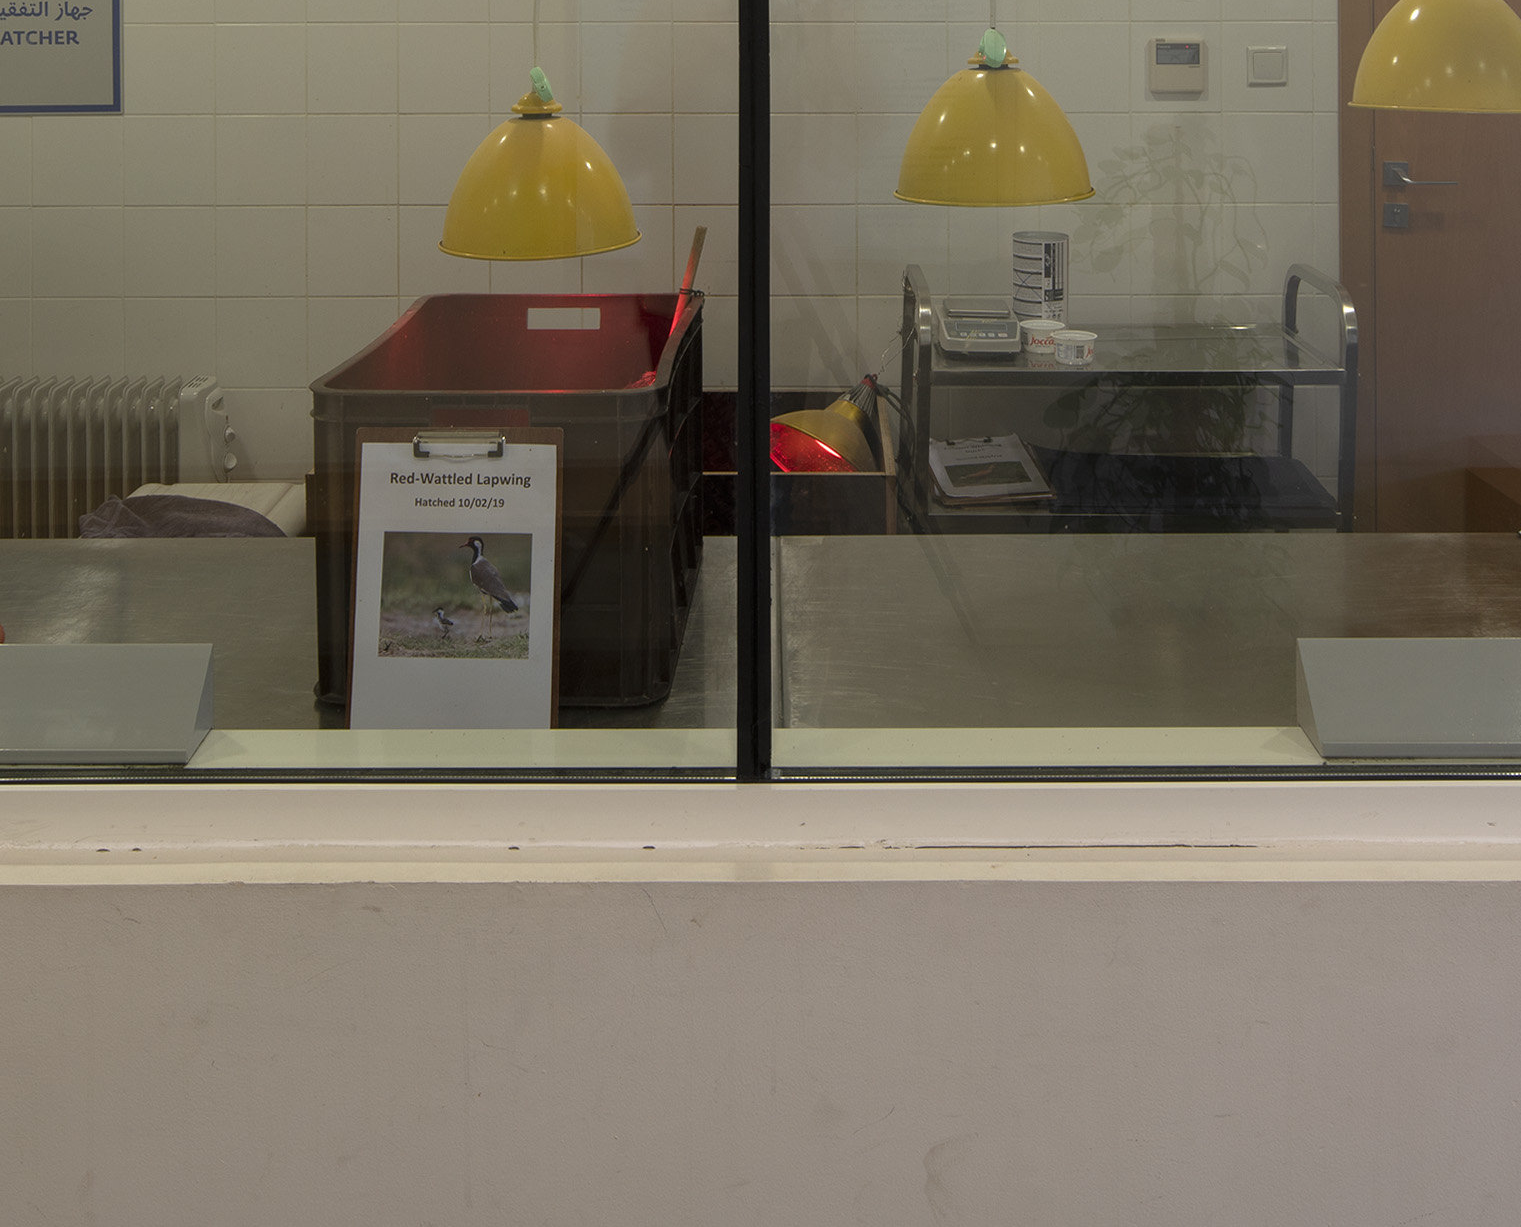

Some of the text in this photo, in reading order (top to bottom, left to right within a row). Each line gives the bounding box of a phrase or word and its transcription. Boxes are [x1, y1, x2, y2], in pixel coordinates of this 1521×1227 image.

[55, 1, 93, 20] جهاز
[390, 472, 532, 489] Red-Wattled Lapwing
[414, 497, 505, 510] Hatched 10/02/19
